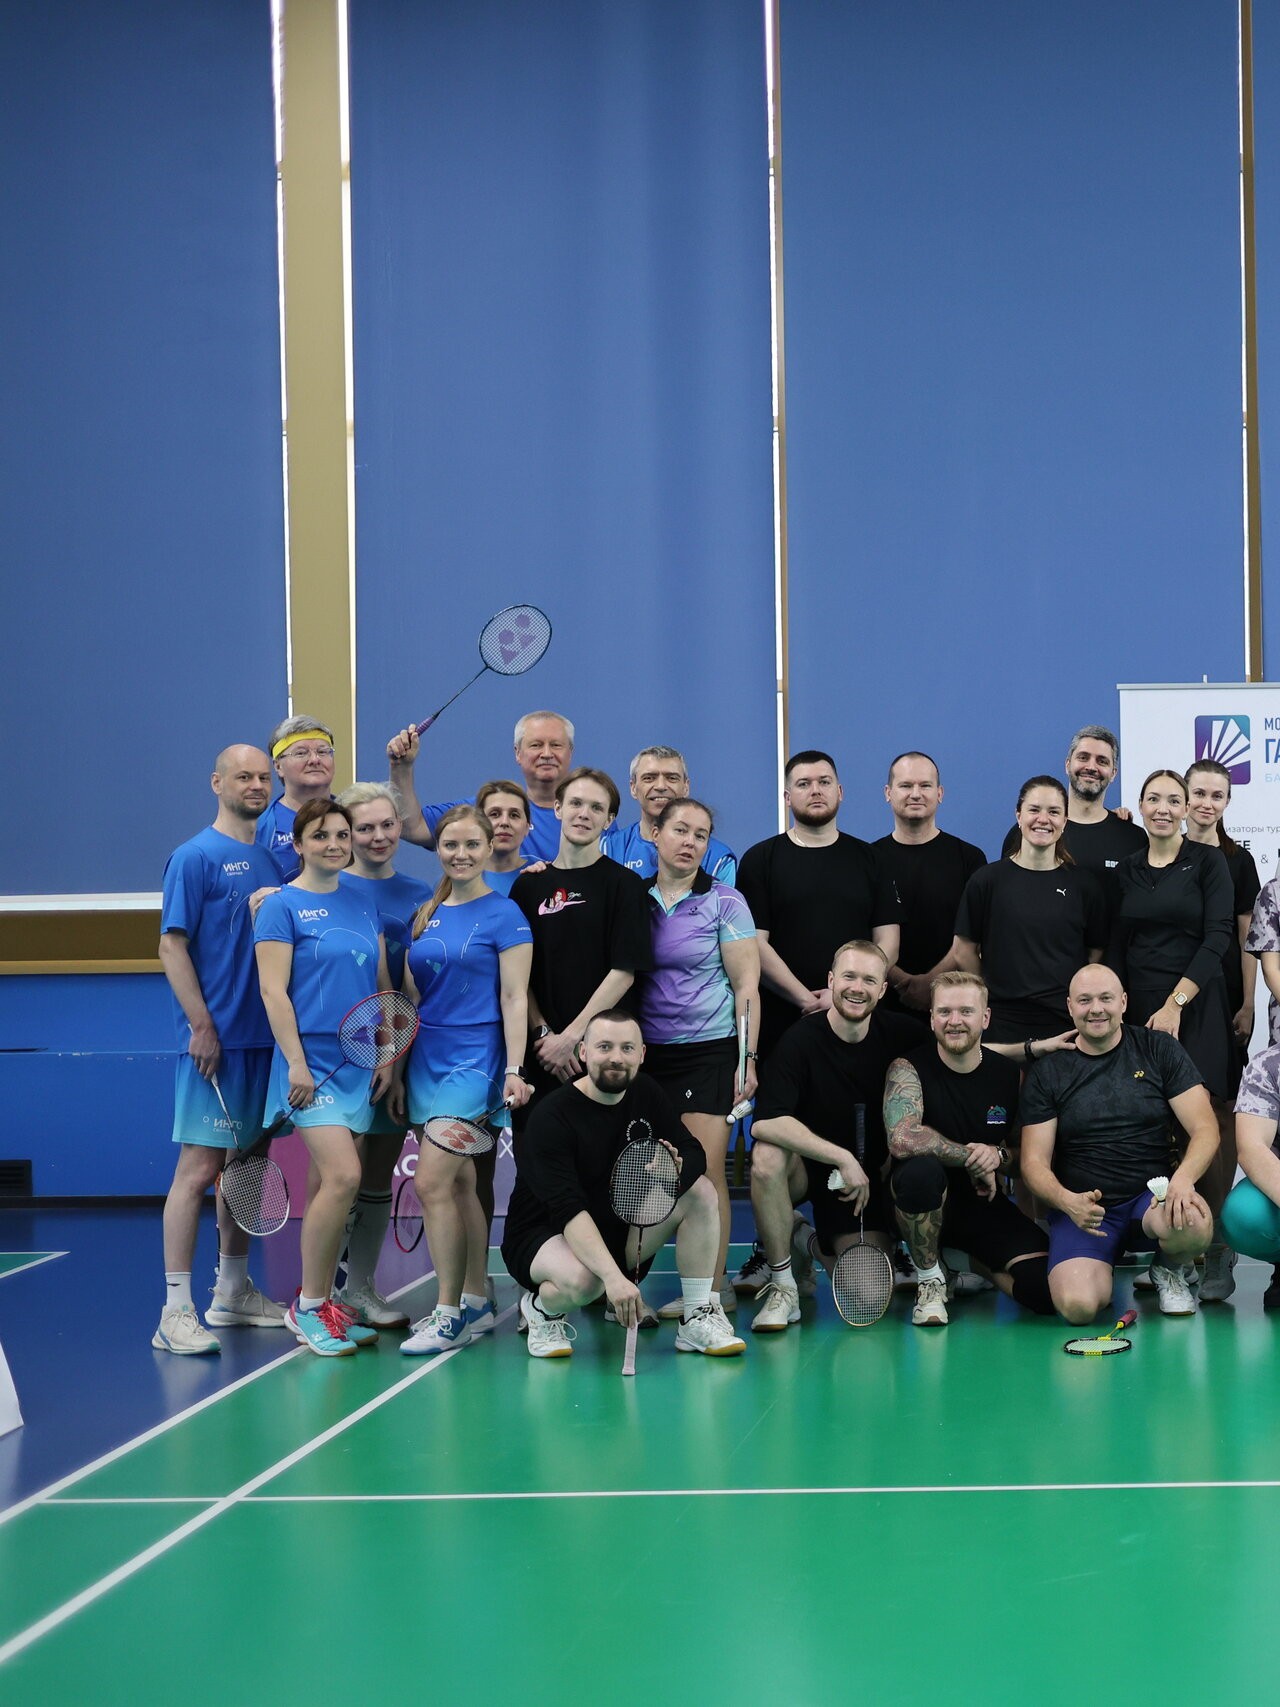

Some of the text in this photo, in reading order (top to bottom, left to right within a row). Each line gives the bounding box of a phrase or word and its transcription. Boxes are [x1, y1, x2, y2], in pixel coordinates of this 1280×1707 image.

[1226, 826, 1264, 834] изаторы
[223, 861, 250, 873] ИНГО
[624, 859, 643, 870] НГО
[297, 908, 329, 919] ИНГО
[213, 1118, 243, 1130] ИНГО
